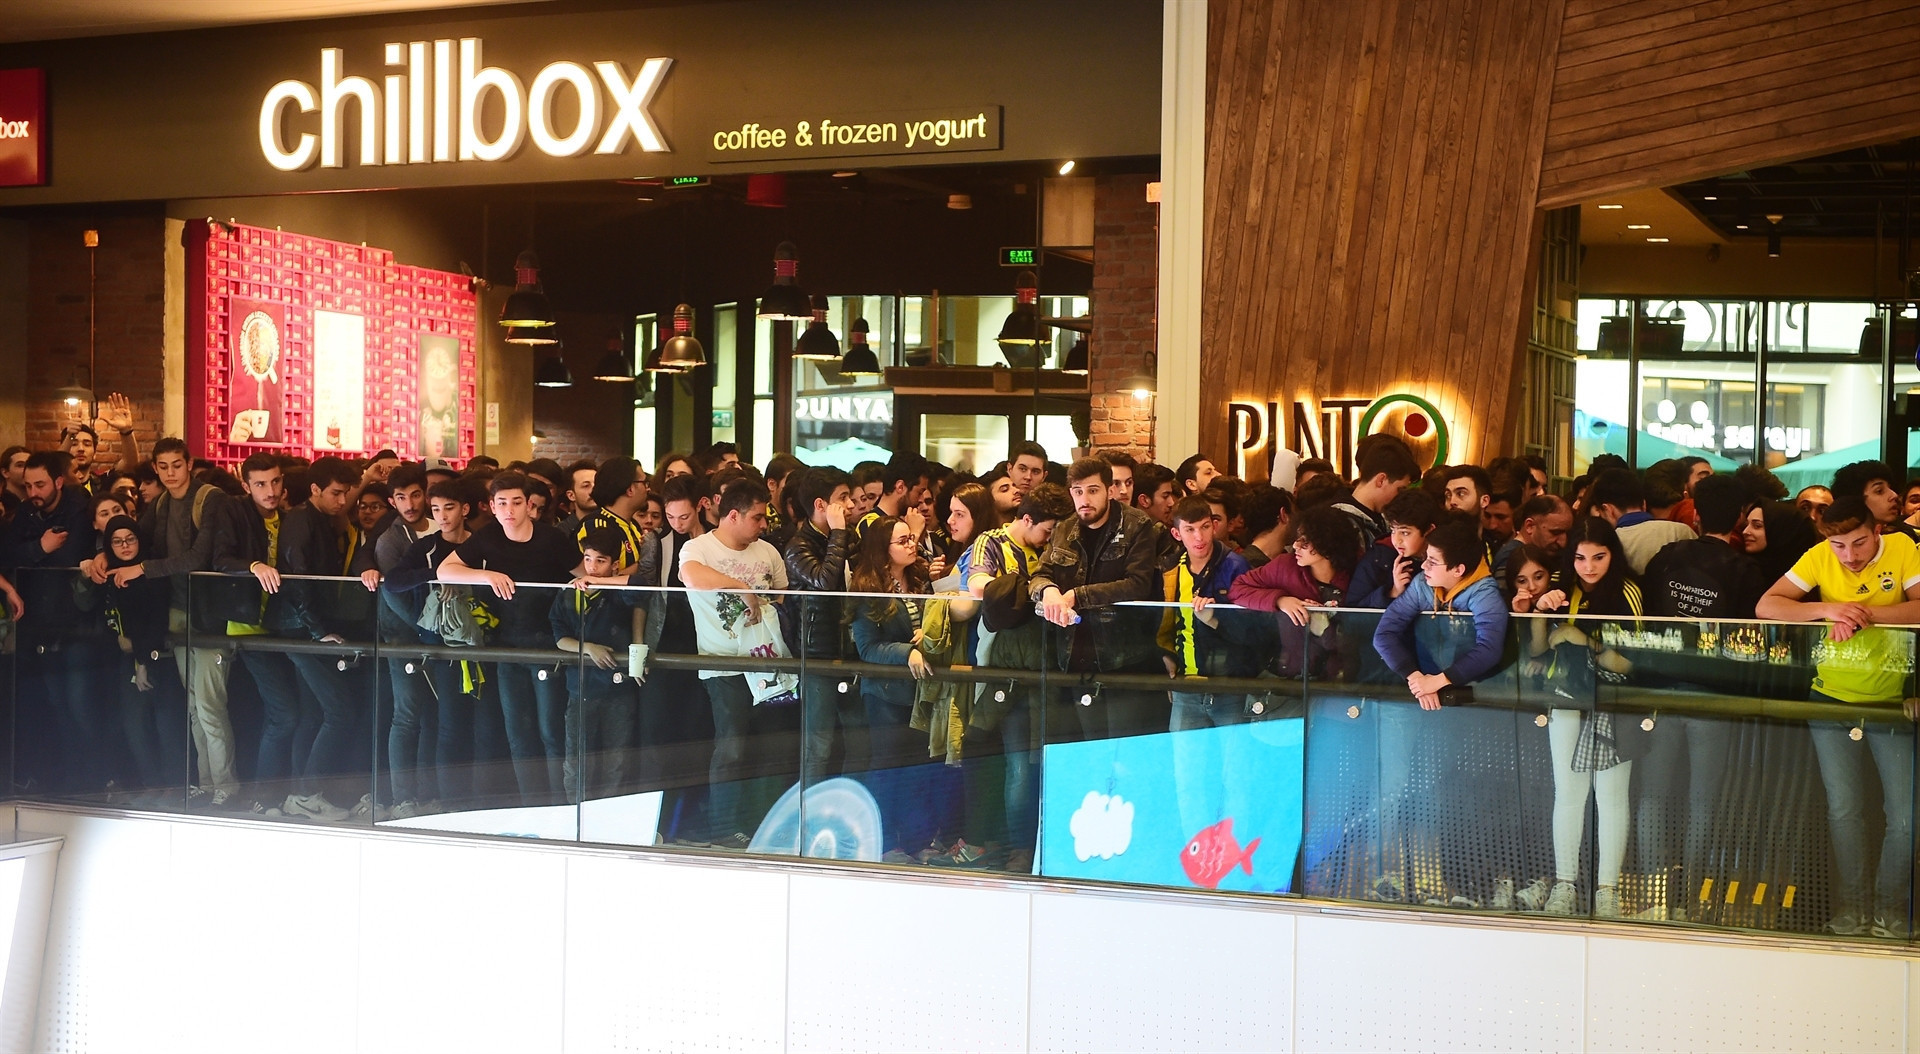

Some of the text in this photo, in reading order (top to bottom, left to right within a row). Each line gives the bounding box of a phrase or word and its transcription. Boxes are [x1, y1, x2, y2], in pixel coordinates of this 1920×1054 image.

[259, 37, 673, 171] chillbox
[713, 113, 987, 150] coffee & frozen yogurt
[1228, 394, 1449, 488] PINTO
[1669, 581, 1718, 598] COMPARISON
[1680, 593, 1694, 602] THE
[1695, 597, 1713, 606] THEIF
[1678, 602, 1688, 610] OF
